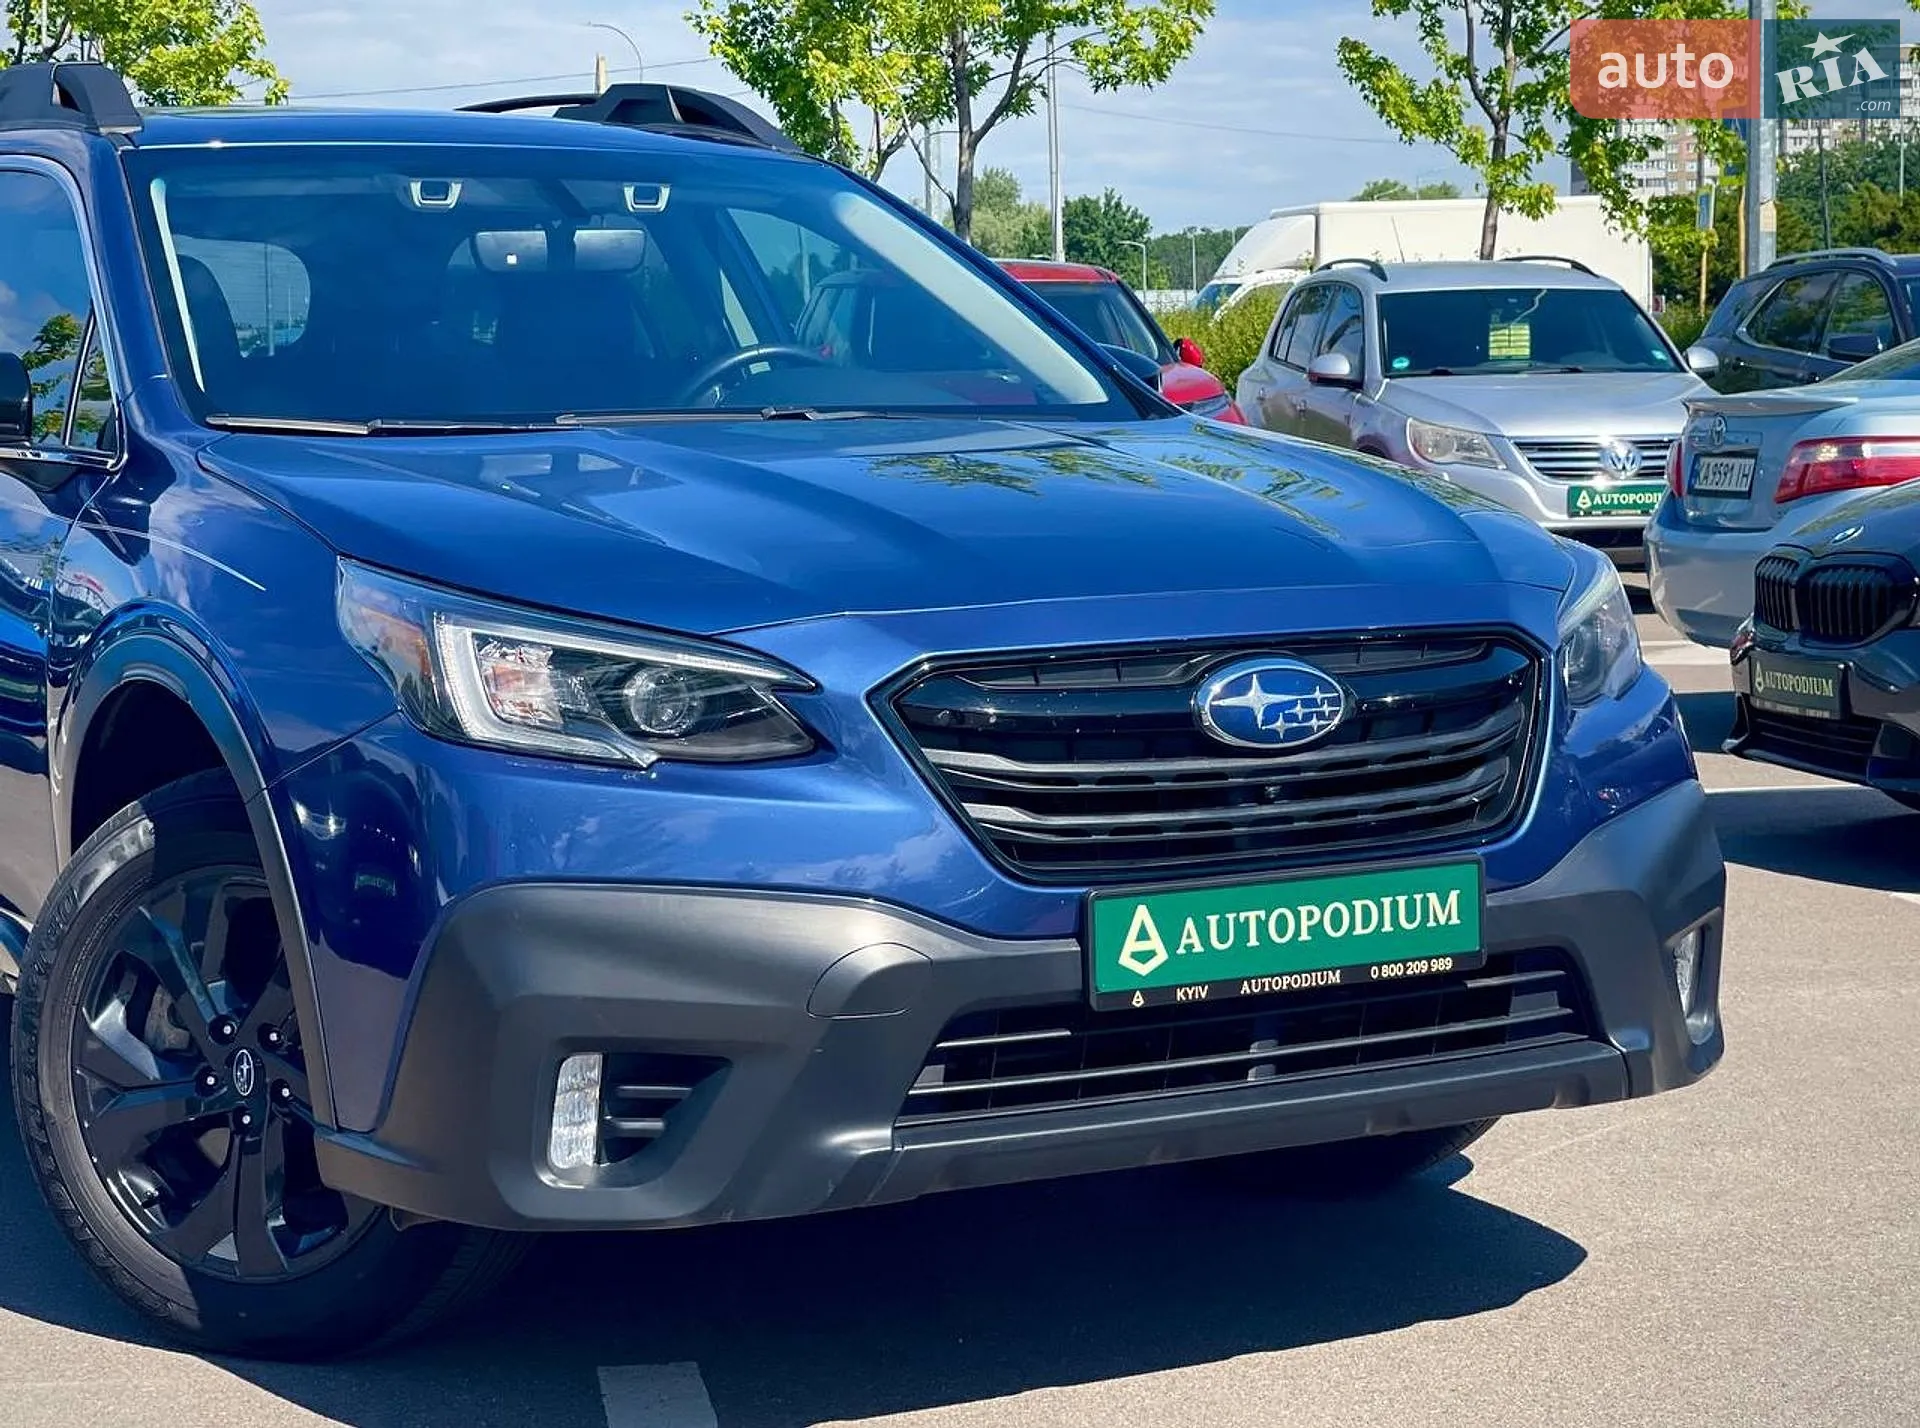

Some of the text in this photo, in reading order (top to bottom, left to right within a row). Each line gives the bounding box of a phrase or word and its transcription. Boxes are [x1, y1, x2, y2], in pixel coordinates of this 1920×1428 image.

[1593, 492, 1662, 505] AUTOPODI
[1763, 671, 1834, 697] AUTOPODIUM
[1175, 889, 1462, 956] AUTOPODIUM
[1176, 985, 1208, 1001] KYIV
[1240, 970, 1341, 994] AUTOPODIUM
[1381, 963, 1404, 978] 800
[1406, 960, 1428, 975] 209
[1430, 957, 1453, 972] 989
